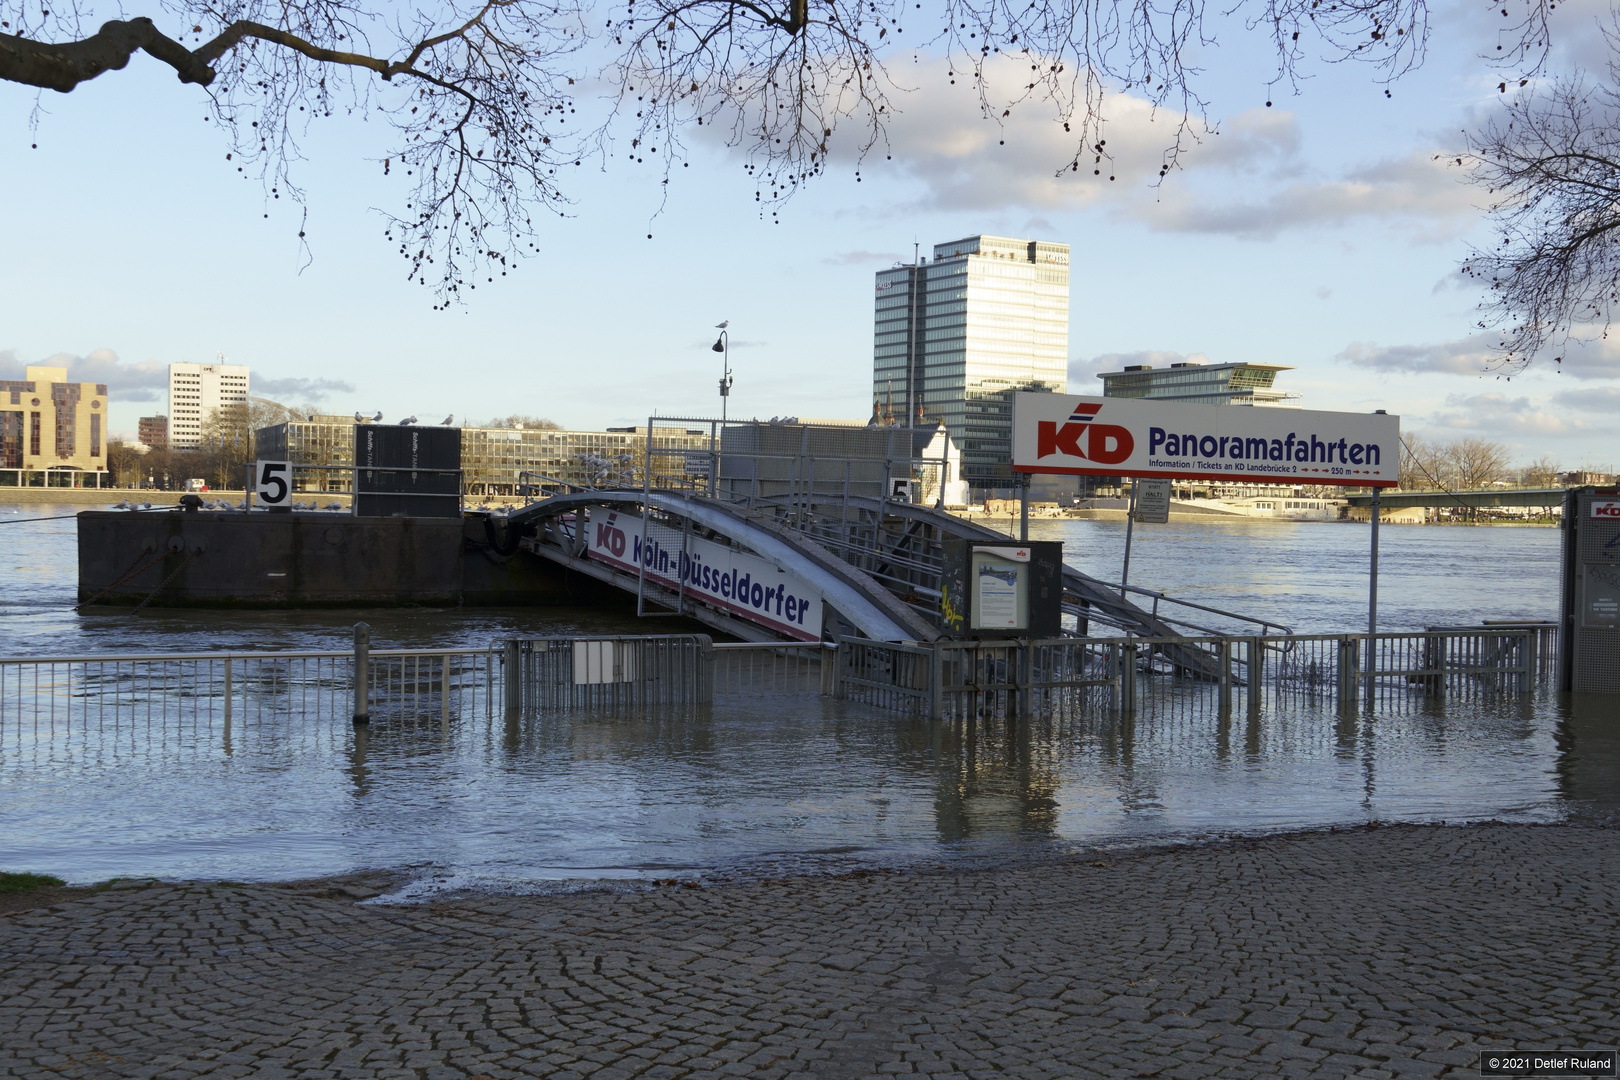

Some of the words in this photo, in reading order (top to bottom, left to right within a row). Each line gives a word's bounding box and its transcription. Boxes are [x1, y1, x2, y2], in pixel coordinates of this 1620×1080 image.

[1037, 403, 1135, 465] KD
[1149, 427, 1381, 466] Panoramafahrten
[260, 463, 288, 504] 5
[1149, 459, 1190, 468] Information
[1197, 461, 1222, 470] Tickets
[1247, 463, 1290, 472] Landebrücke
[1292, 465, 1297, 473] 2
[1331, 467, 1343, 475] 250
[597, 512, 626, 558] KD
[633, 535, 809, 625] Köln-Düsseldorfer
